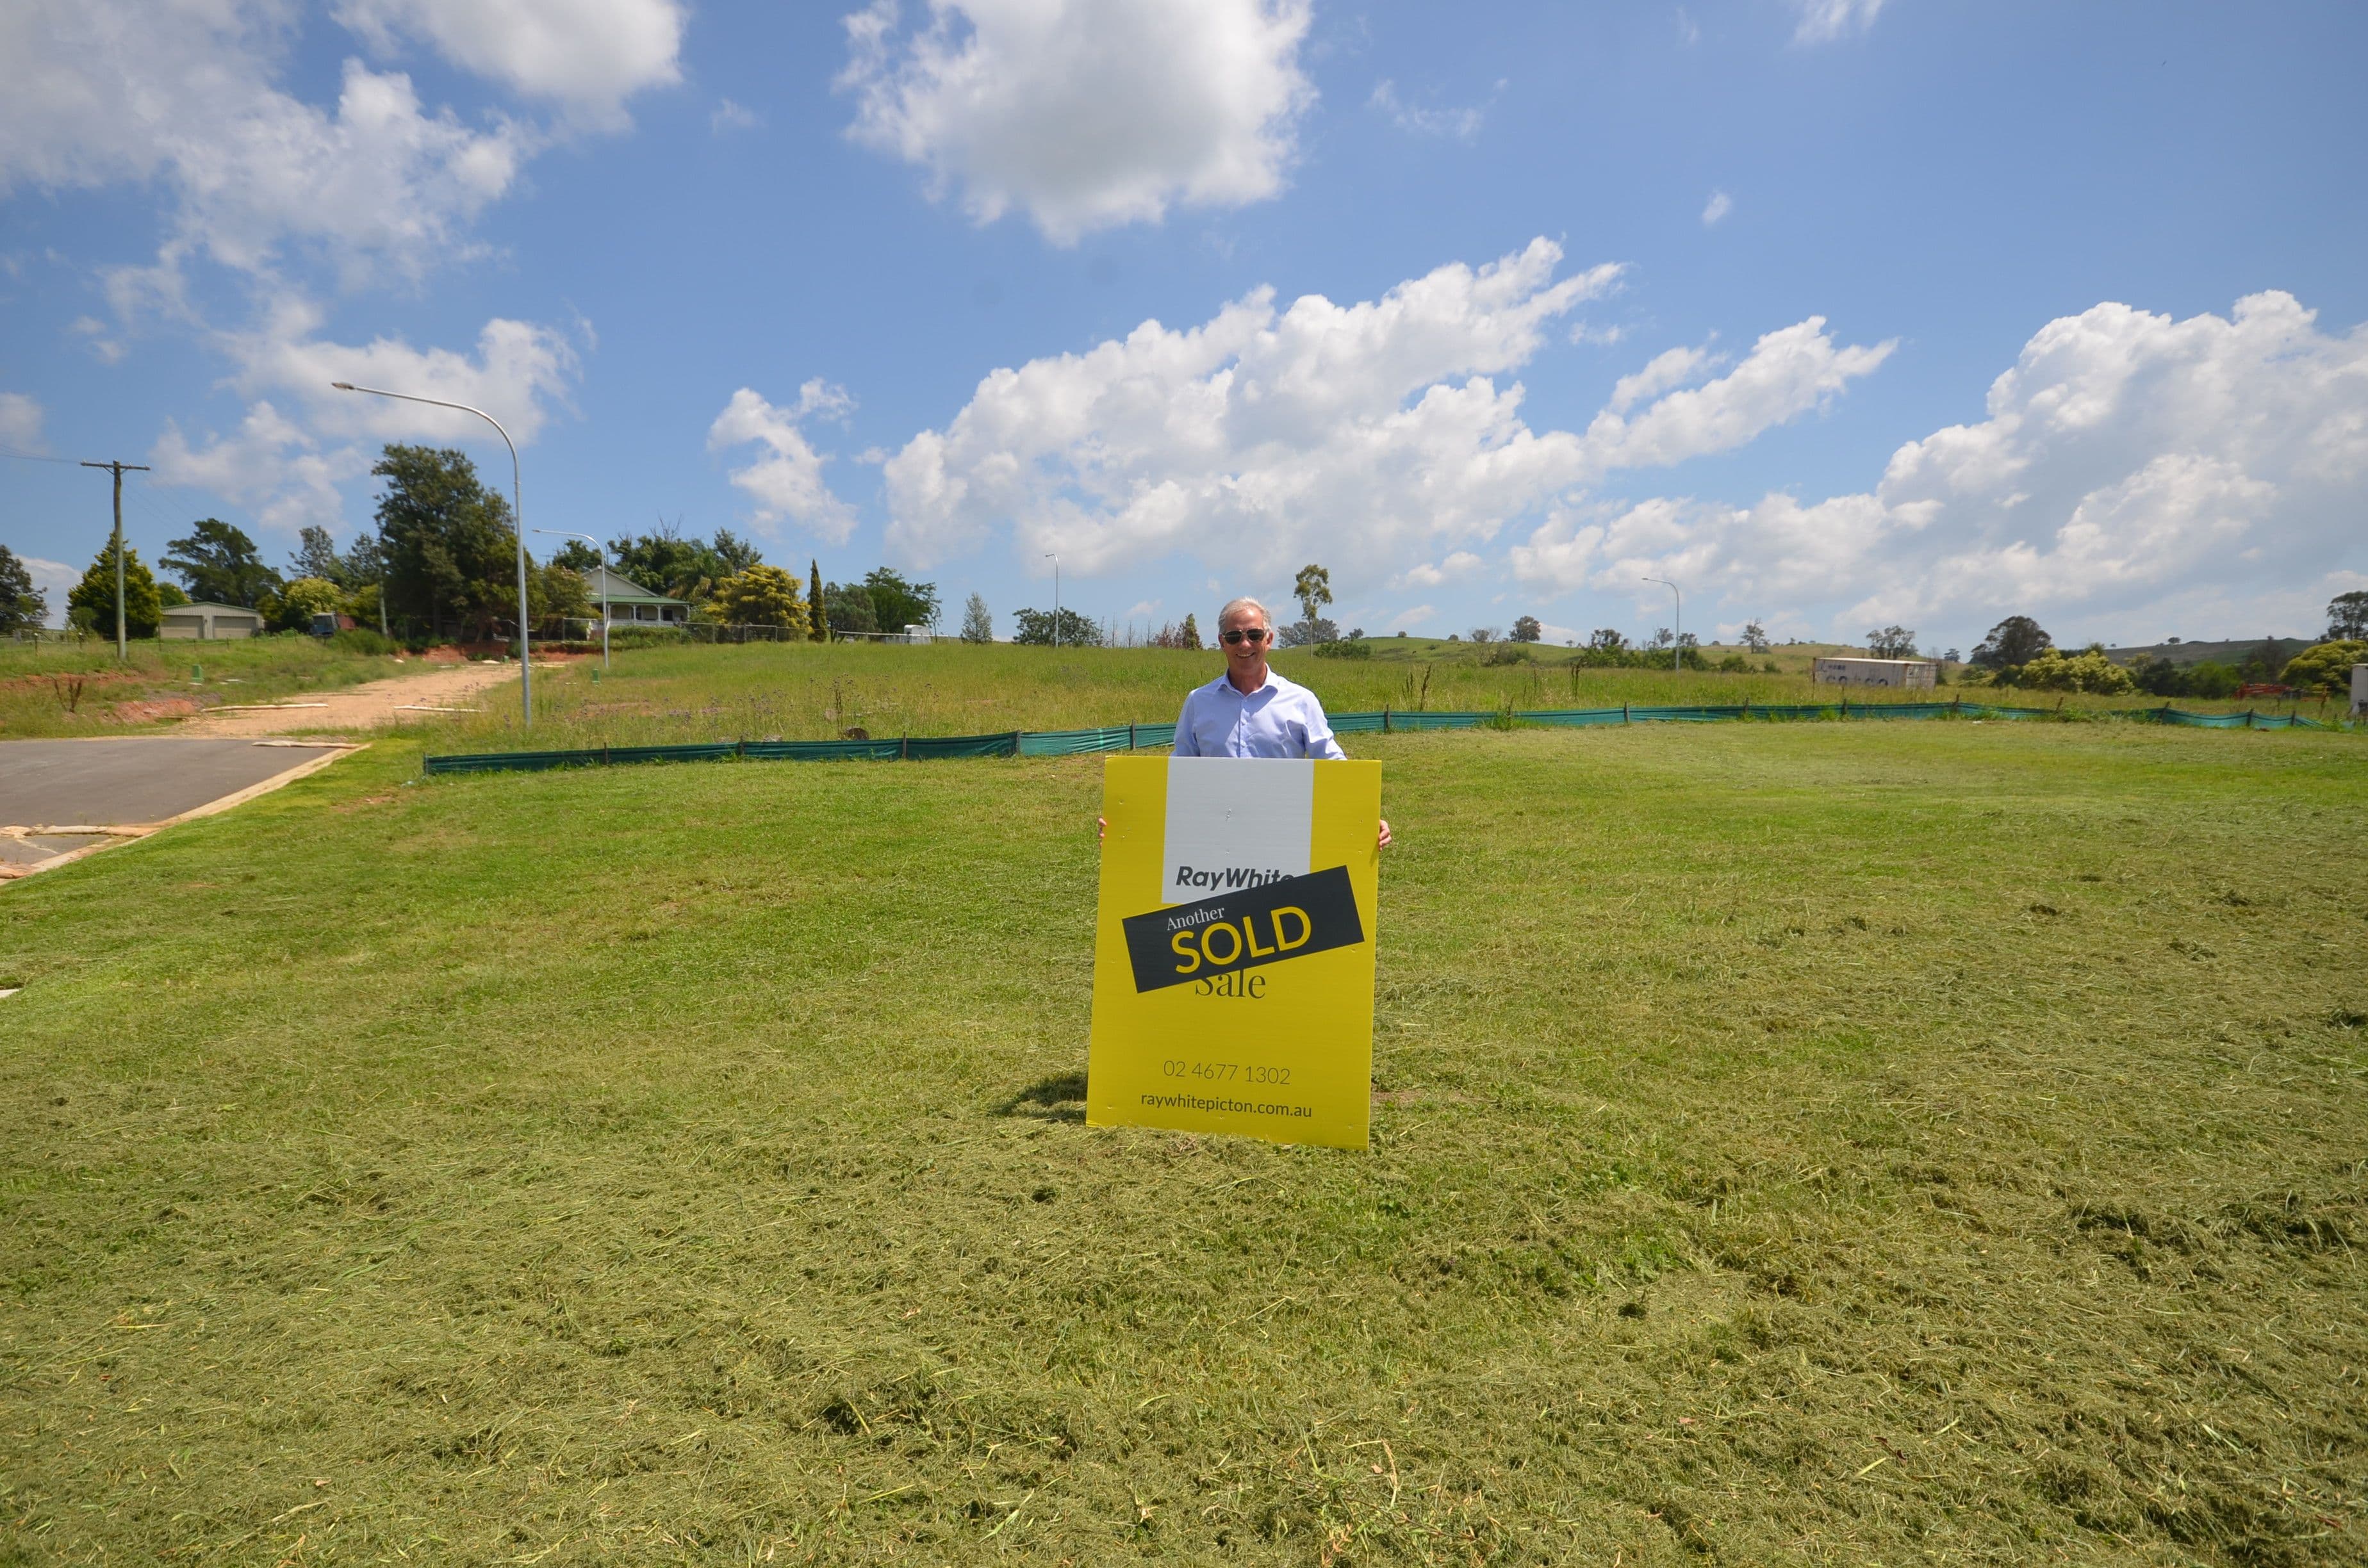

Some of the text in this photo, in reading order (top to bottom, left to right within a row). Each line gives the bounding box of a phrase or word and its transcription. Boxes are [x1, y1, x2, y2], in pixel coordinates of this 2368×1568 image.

[1167, 908, 1224, 931] Another
[1172, 906, 1311, 974] SOLD
[1163, 1060, 1290, 1085] 02 4677 1302
[1141, 1093, 1312, 1118] raywhitepicton.com.au
